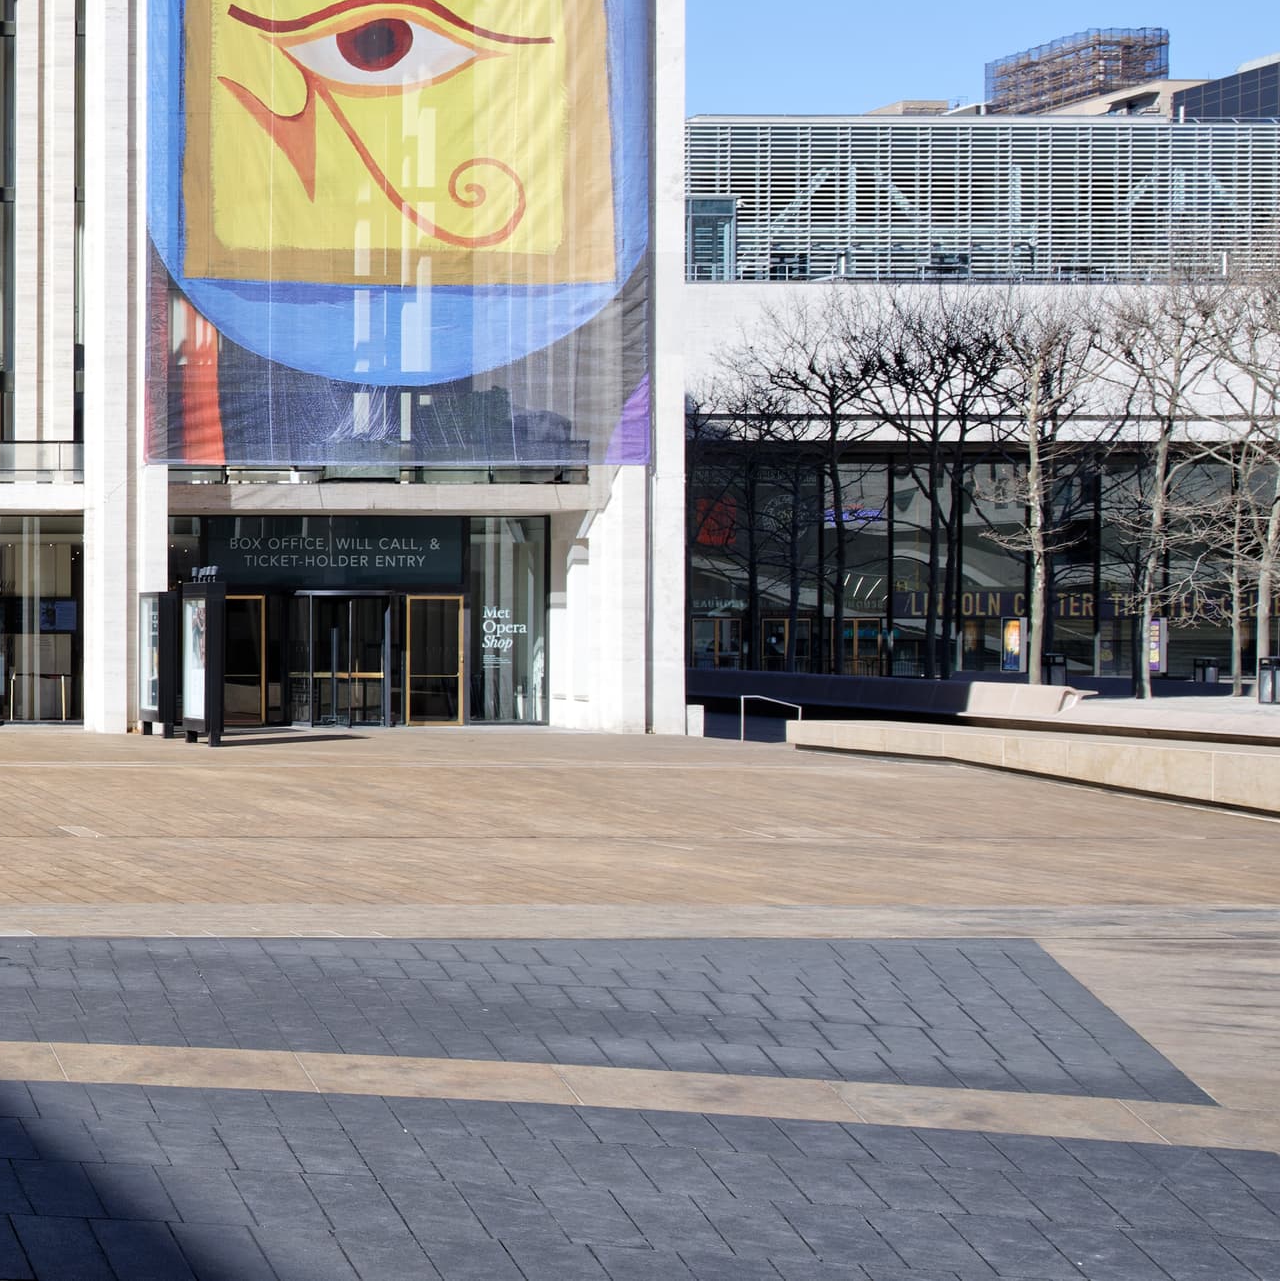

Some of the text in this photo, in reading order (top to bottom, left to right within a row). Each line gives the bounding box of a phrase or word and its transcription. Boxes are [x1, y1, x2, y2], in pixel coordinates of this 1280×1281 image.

[229, 537, 441, 551] BOX OFFICE, WILL CALL, &
[243, 554, 427, 567] TICKET-HOLDER ENTRY
[482, 605, 511, 619] Met
[1013, 592, 1095, 617] CTER
[482, 619, 528, 637] Opera
[481, 634, 514, 652] Shop
